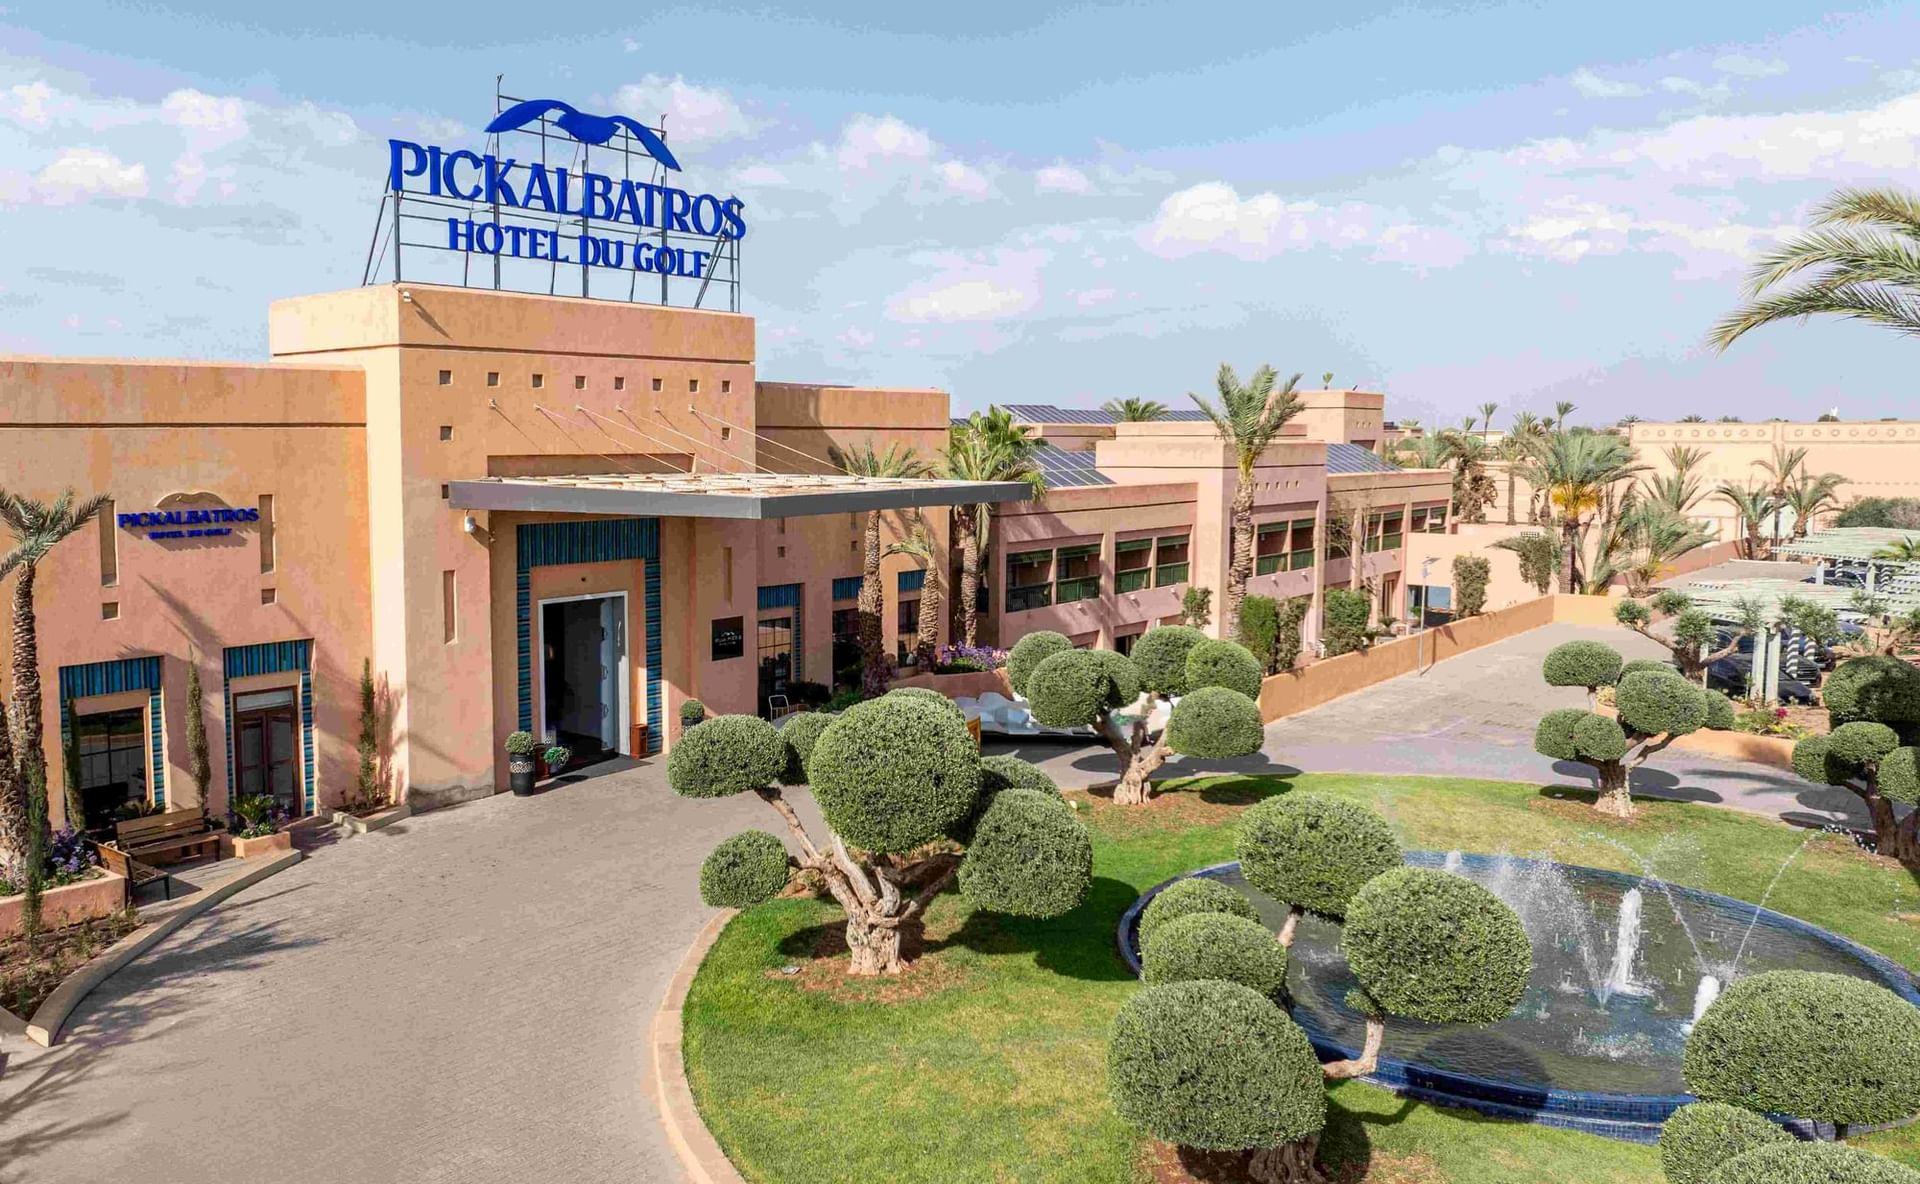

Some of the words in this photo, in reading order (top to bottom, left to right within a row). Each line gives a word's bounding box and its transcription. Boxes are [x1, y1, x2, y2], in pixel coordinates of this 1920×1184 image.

[389, 139, 746, 241] PICKALBATROS
[448, 217, 569, 262] HOTEL
[578, 234, 624, 268] DU
[633, 242, 710, 279] GOLF
[117, 508, 260, 528] PICKALBATROS
